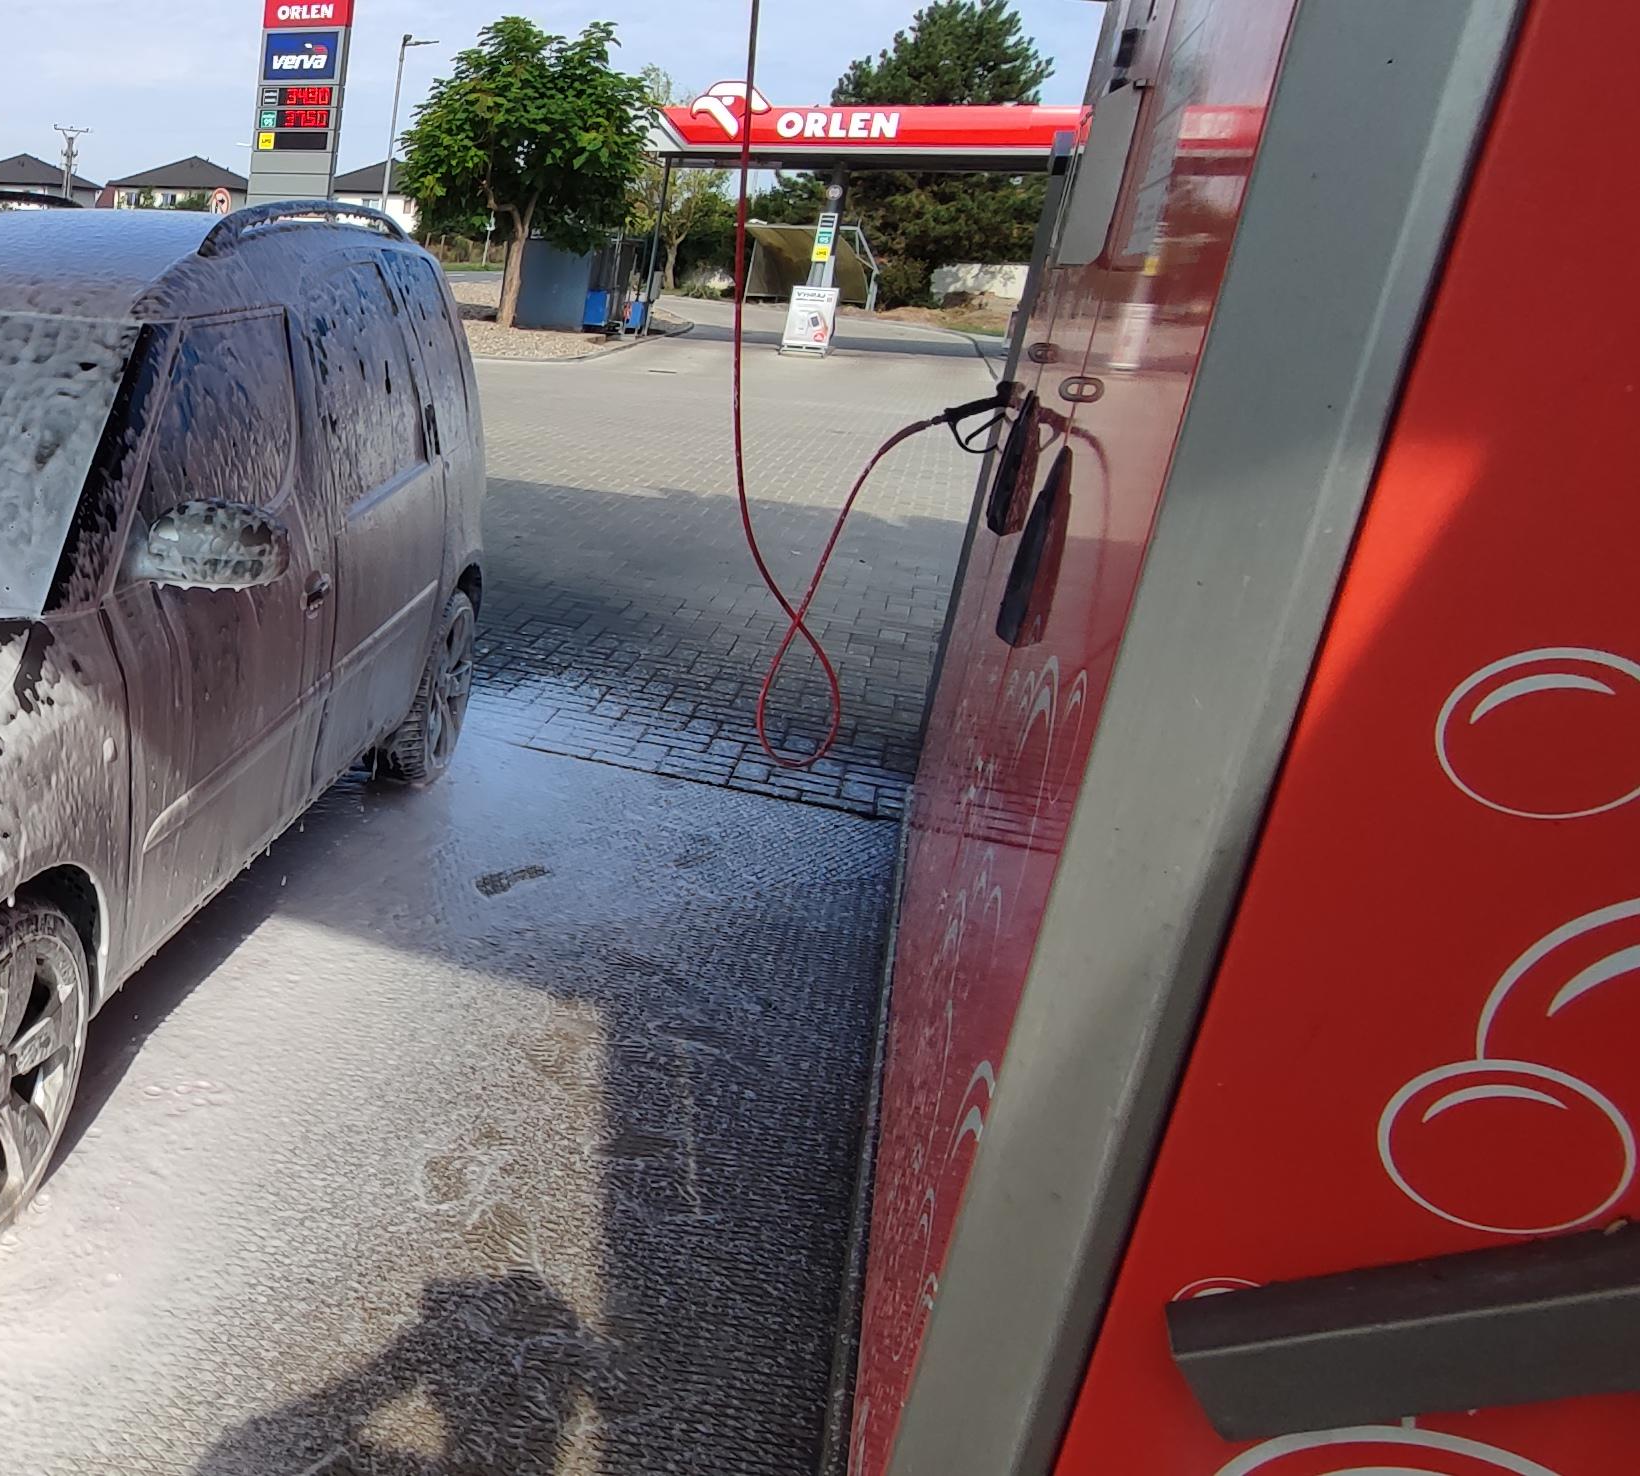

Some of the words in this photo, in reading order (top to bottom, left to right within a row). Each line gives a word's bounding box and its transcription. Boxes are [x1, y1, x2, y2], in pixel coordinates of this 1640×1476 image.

[277, 4, 334, 20] ORLEN
[272, 54, 327, 70] verva
[777, 111, 900, 138] ORLEN
